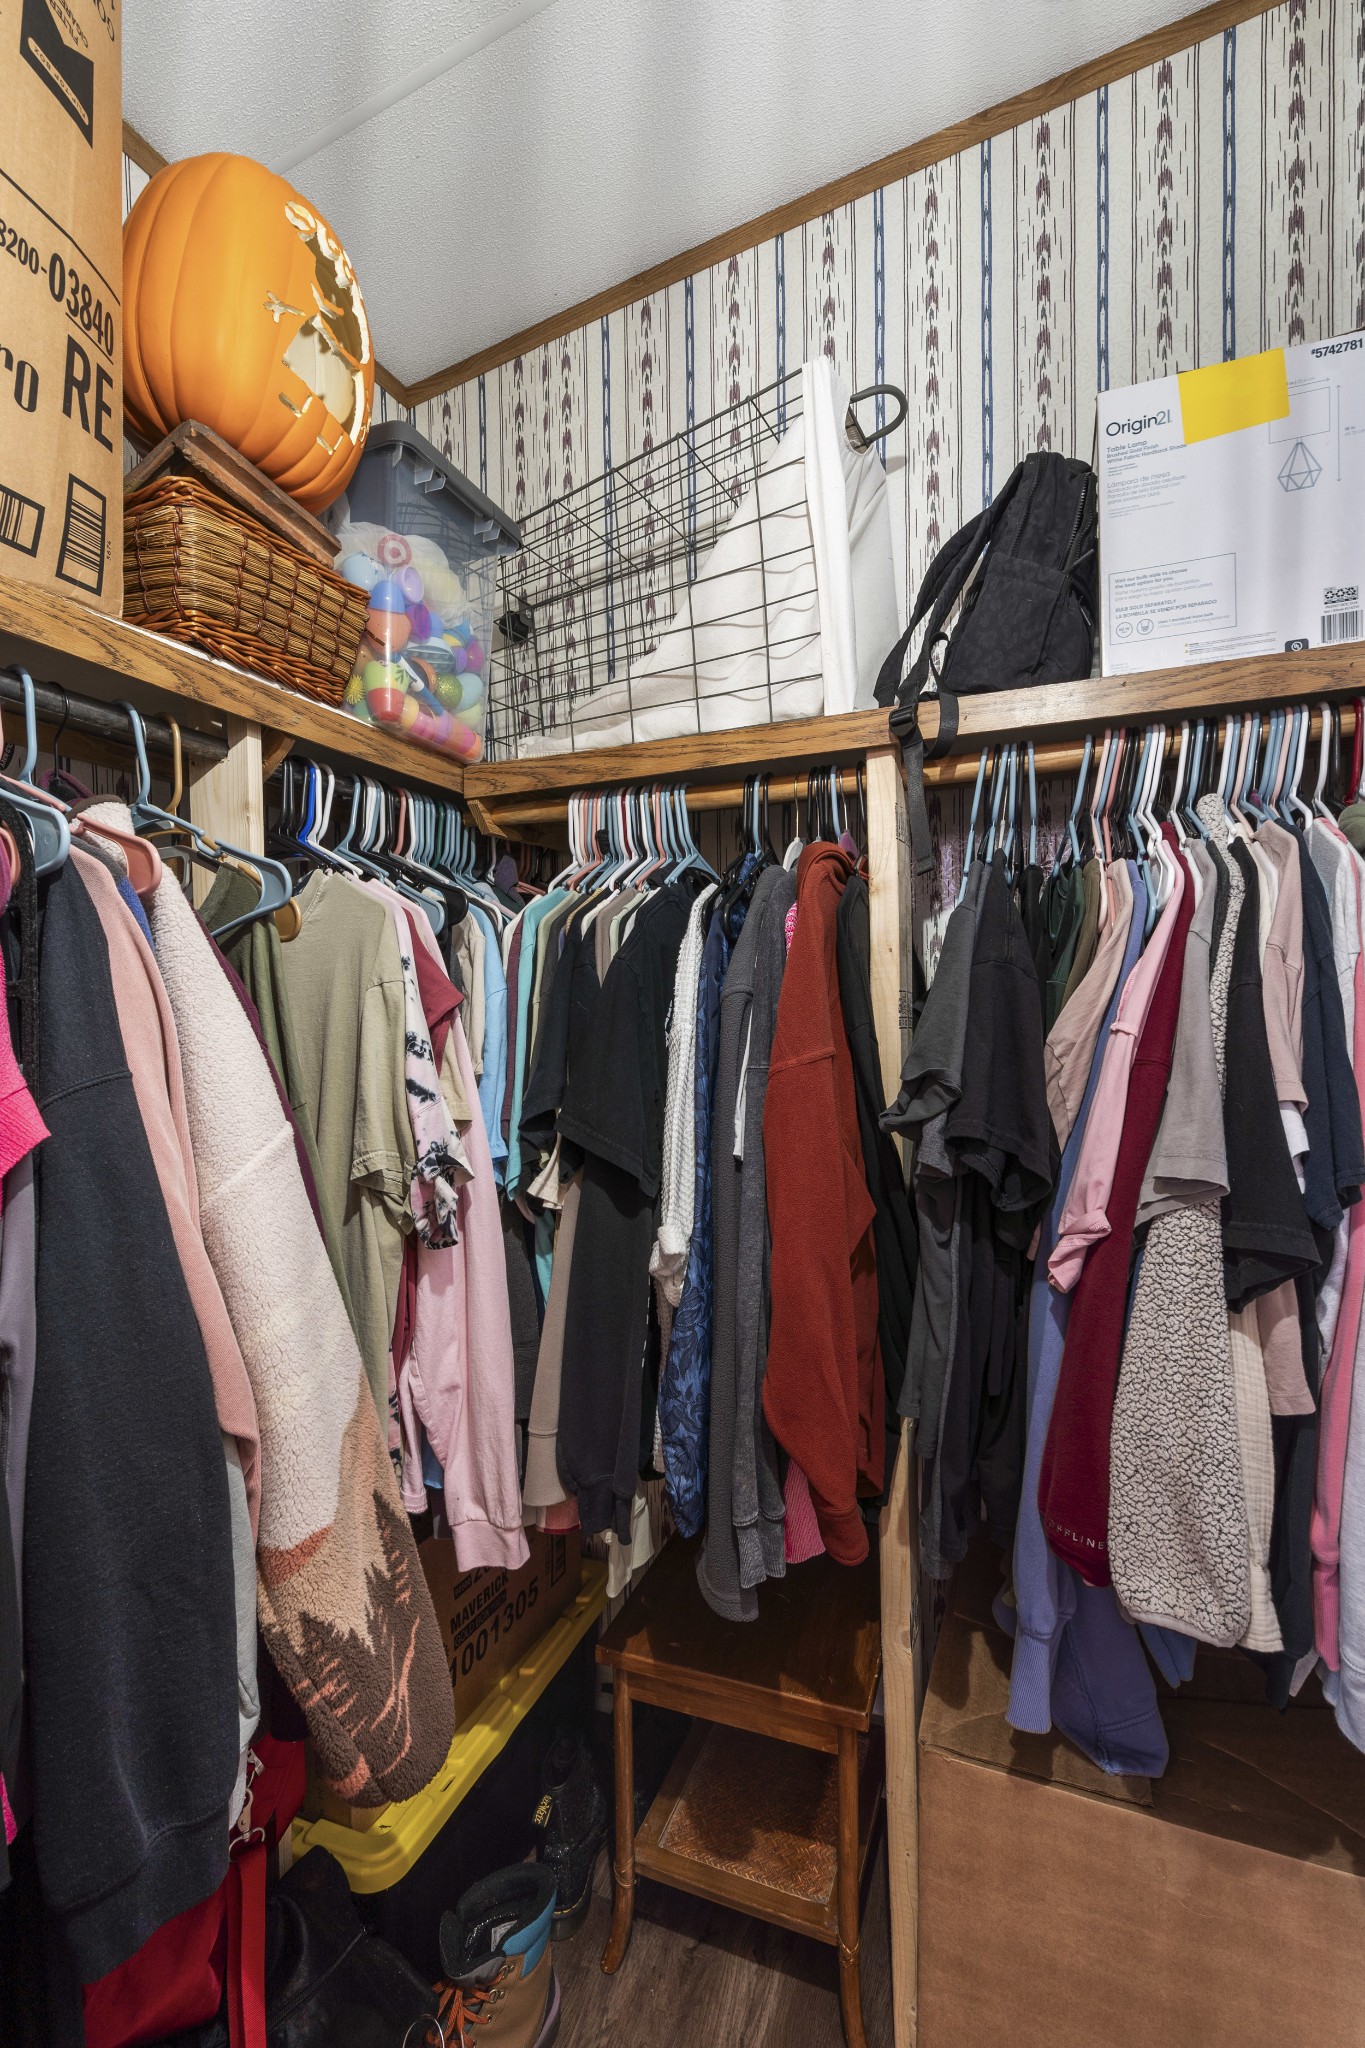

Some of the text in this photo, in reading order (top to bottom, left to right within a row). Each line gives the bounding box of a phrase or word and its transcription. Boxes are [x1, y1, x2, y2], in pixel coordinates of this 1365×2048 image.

[33, 45, 87, 119] FLIP-TOP BOX
[1311, 338, 1363, 358] #5742781
[1106, 409, 1172, 436] Origin21
[1107, 440, 1148, 453] Table Lamp
[1107, 450, 1128, 459] Brushed
[1143, 443, 1159, 451] Finish
[1107, 456, 1123, 464] White
[1124, 453, 1141, 461] Fabric
[1142, 448, 1168, 457] Hardback
[1151, 472, 1170, 480] mesa
[1122, 610, 1149, 618] BOMBILLA
[1188, 599, 1218, 608] SEPARADO
[1144, 599, 1177, 608] SEPARATELY
[1046, 1518, 1105, 1549] OFFLINE
[451, 1567, 509, 1634] MAVERICK
